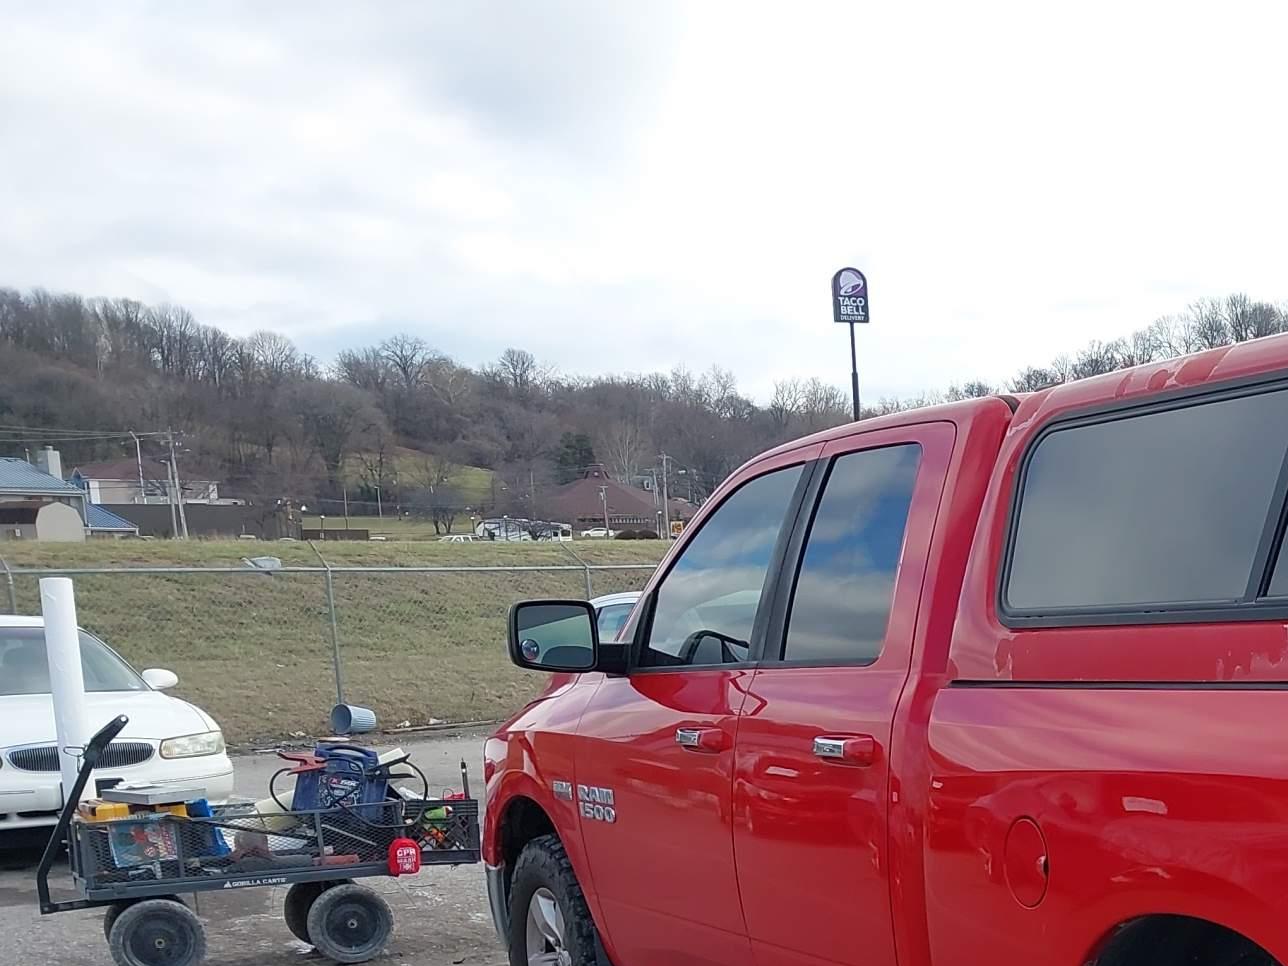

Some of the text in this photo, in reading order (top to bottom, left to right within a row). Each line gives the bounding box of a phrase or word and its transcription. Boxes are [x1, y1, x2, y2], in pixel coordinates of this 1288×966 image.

[838, 296, 865, 306] TACO
[840, 306, 866, 315] BELL
[577, 784, 615, 805] RAM
[579, 801, 617, 824] 1500
[396, 847, 417, 857] CPR
[232, 879, 261, 888] GORILLA
